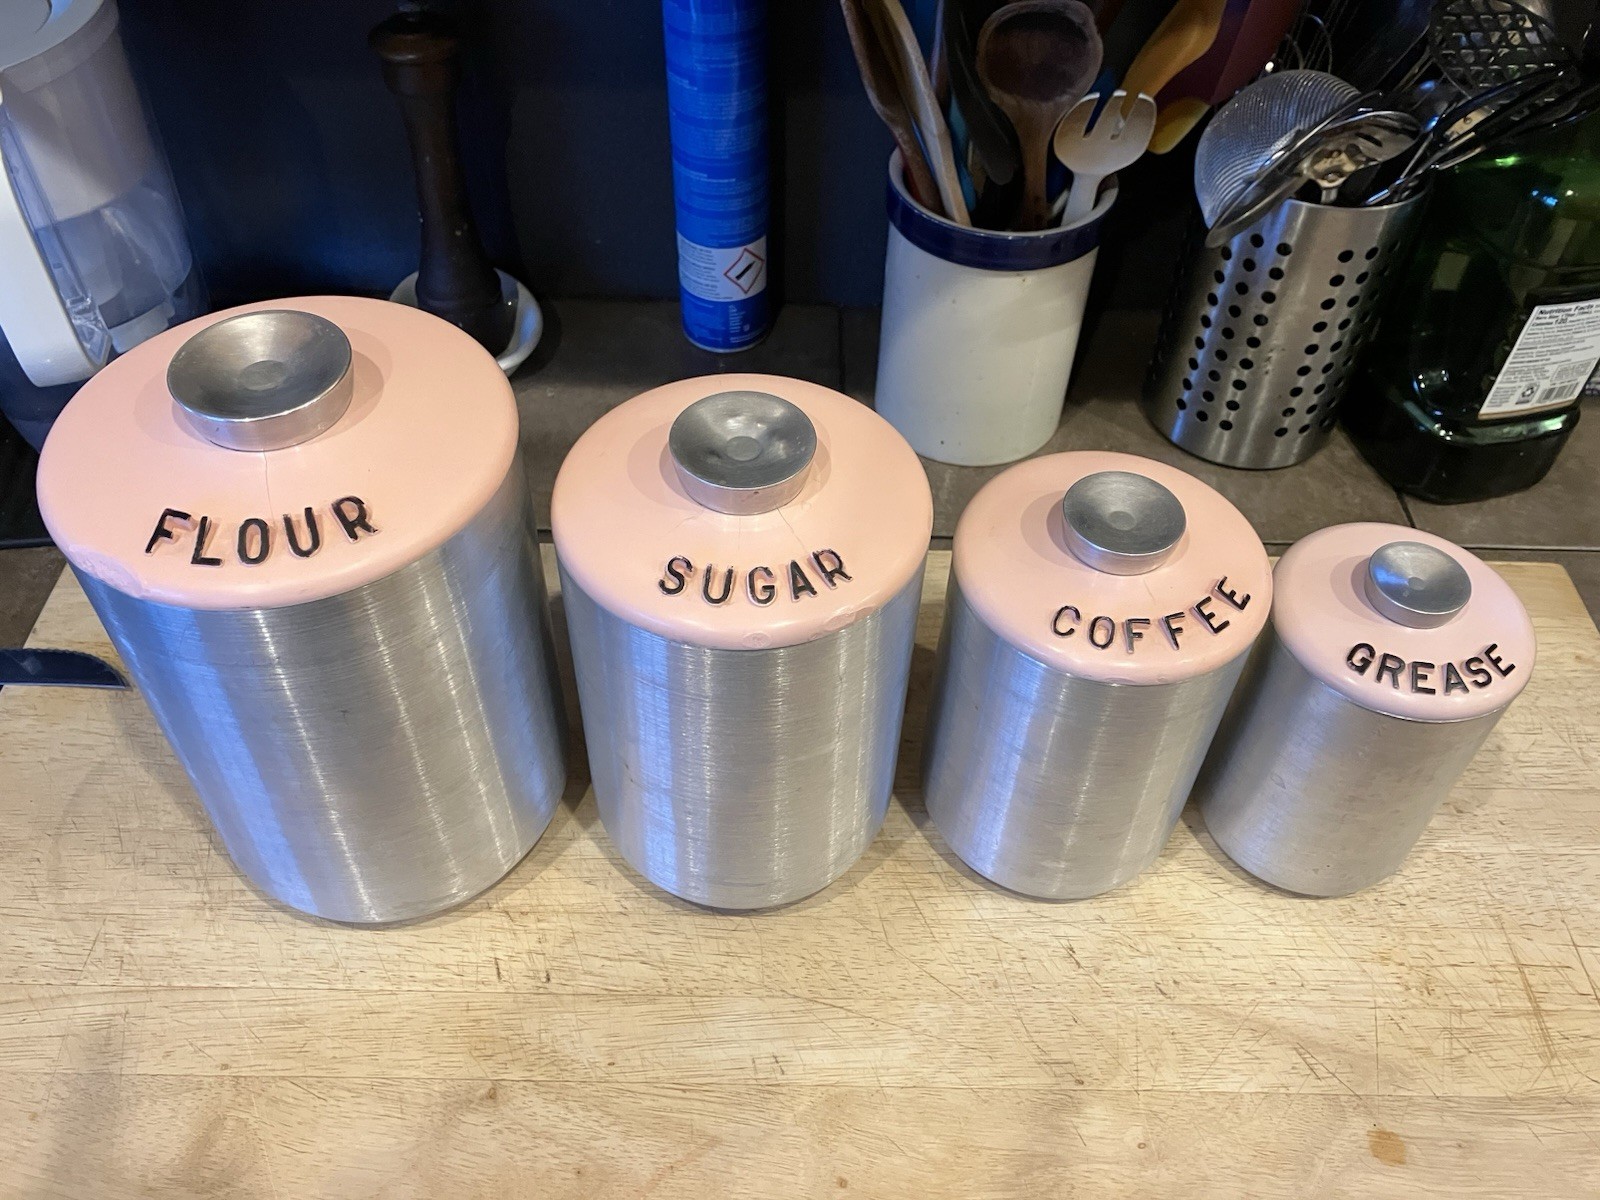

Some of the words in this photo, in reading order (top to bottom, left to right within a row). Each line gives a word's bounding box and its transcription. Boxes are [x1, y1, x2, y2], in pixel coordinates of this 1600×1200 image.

[144, 495, 380, 566] FLOUR
[658, 548, 853, 607] SUGAR
[1051, 576, 1252, 654] COFFEE
[1346, 642, 1517, 696] GREASE
